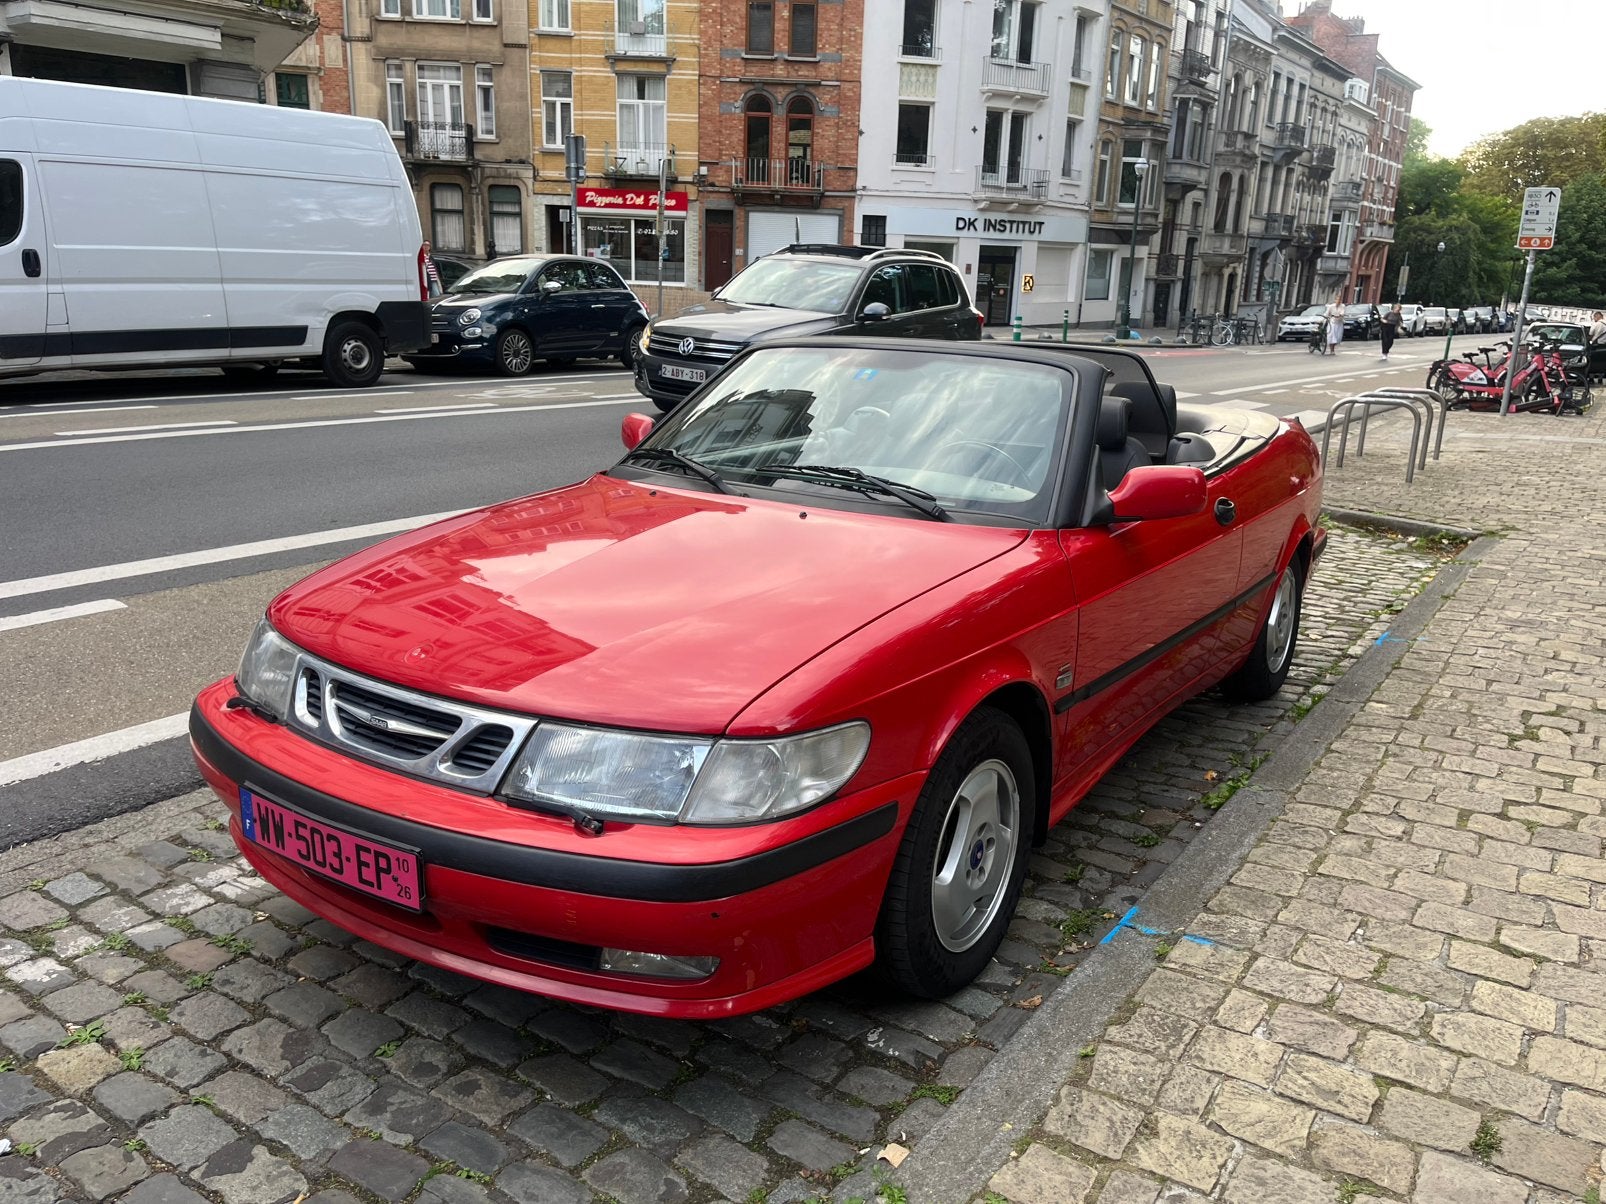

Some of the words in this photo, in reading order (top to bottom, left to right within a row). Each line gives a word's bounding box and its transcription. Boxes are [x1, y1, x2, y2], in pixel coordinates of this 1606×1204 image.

[585, 191, 624, 207] Pizzeria
[625, 193, 644, 205] Del
[648, 194, 677, 206] Pco
[955, 217, 978, 232] DK
[983, 218, 1045, 235] INSTITUT
[662, 366, 704, 381] 2-ABY-318
[370, 717, 387, 729] SAAB
[246, 818, 251, 830] F
[395, 856, 410, 873] 10
[397, 883, 412, 900] 26
